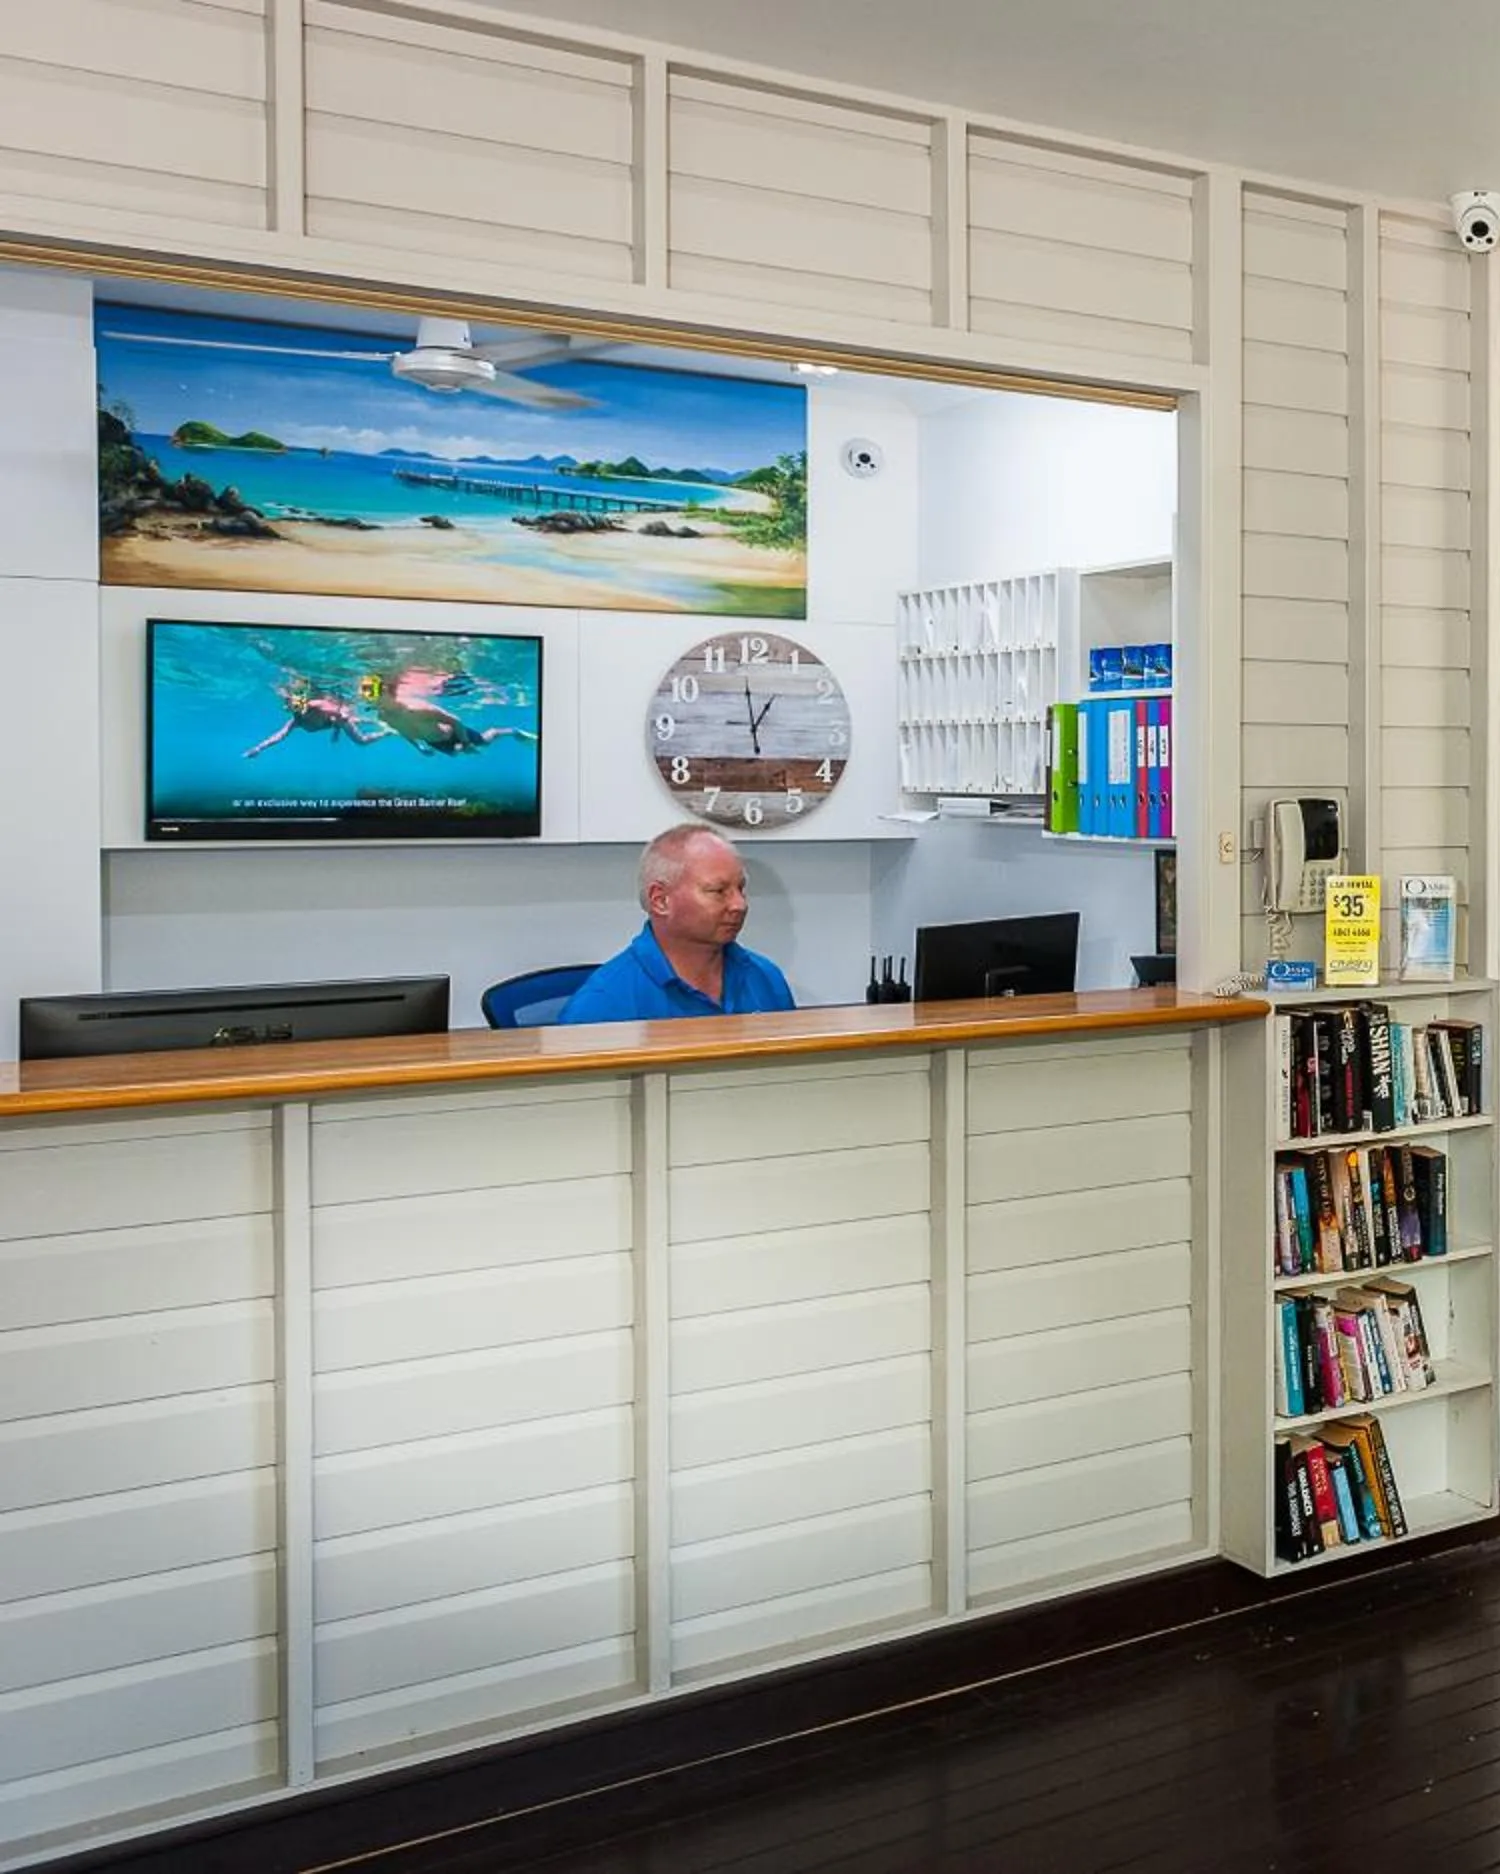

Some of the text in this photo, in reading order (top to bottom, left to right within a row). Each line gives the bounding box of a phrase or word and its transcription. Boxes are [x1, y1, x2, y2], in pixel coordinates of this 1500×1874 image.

[703, 646, 727, 673] 11
[739, 637, 769, 665] 12
[789, 651, 800, 674] 1
[671, 675, 699, 703] 10
[816, 679, 834, 704] 2
[655, 714, 675, 741] 9
[828, 721, 847, 746] 3
[671, 756, 691, 784] 8
[815, 758, 834, 783] 4
[257, 797, 298, 807] exclusive
[299, 797, 317, 809] way
[330, 797, 376, 808] experience
[378, 797, 392, 807] the
[394, 797, 417, 807] Great
[418, 797, 445, 807] Barrier
[447, 797, 467, 807] Reef
[703, 786, 721, 812] 7
[744, 798, 763, 825] 6
[785, 788, 803, 813] 5
[1333, 895, 1365, 917] $35
